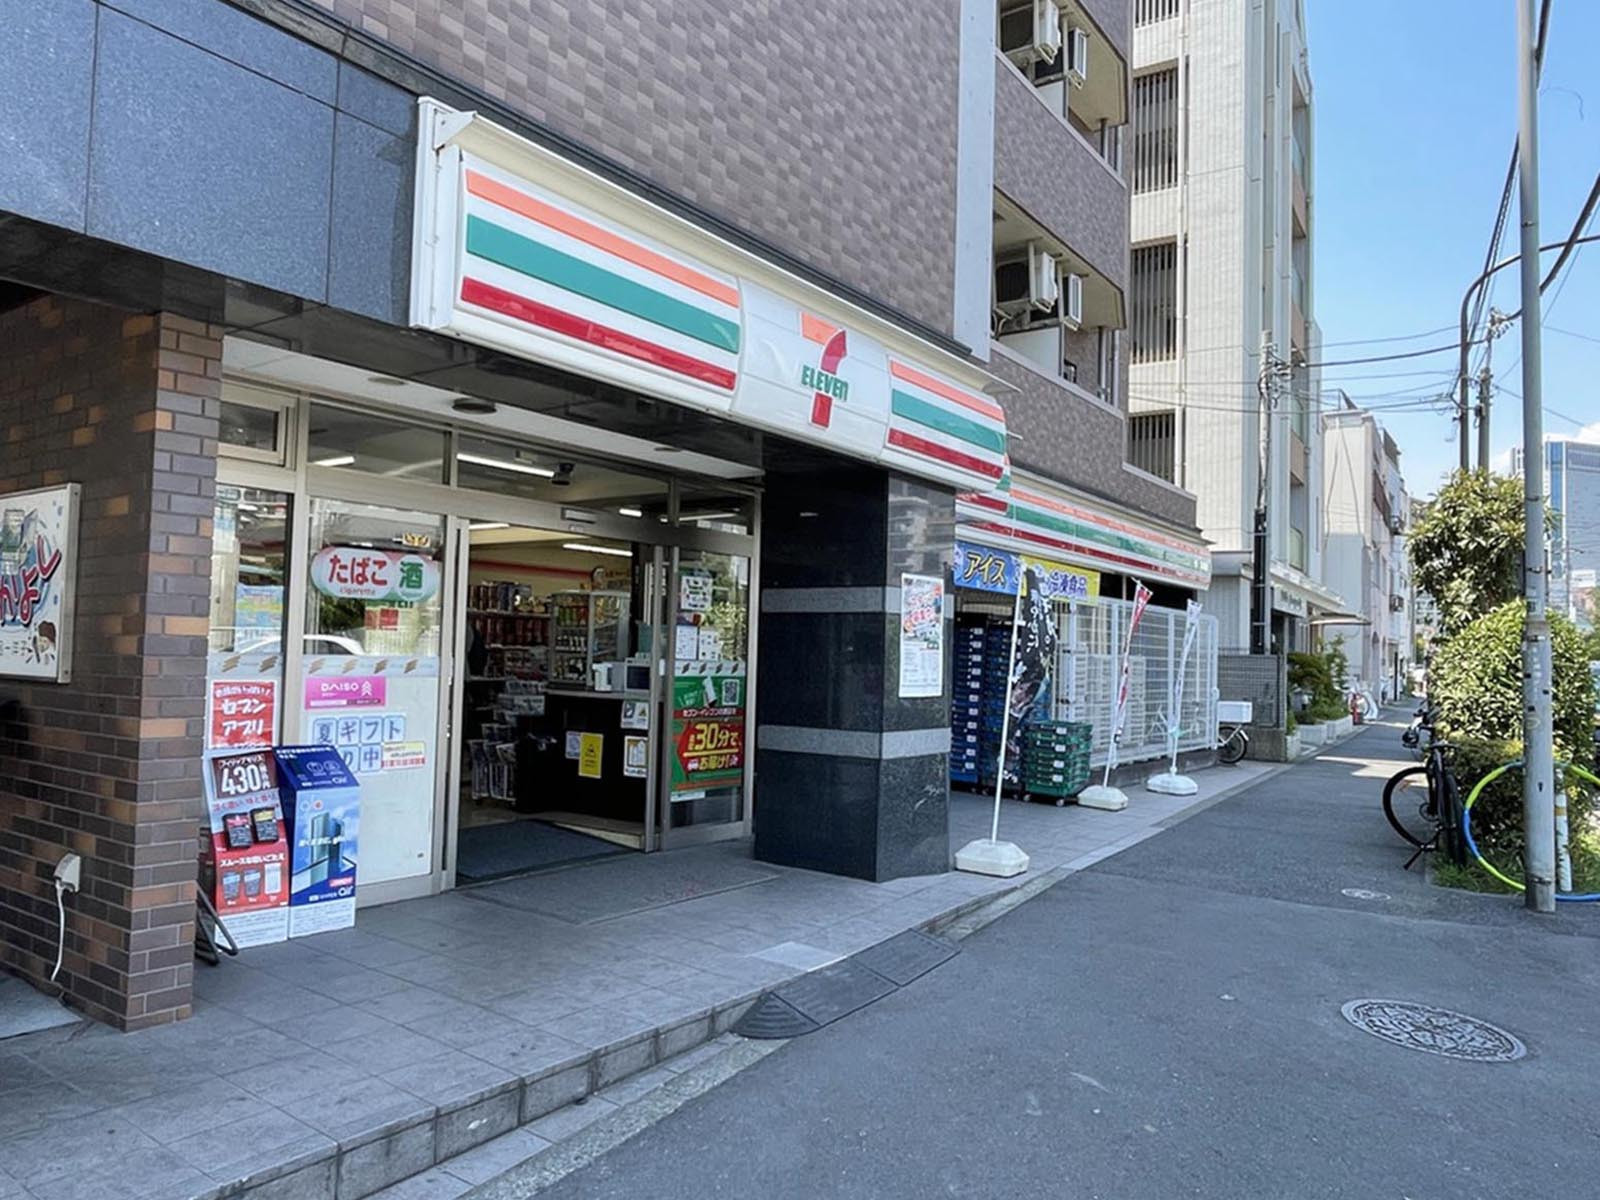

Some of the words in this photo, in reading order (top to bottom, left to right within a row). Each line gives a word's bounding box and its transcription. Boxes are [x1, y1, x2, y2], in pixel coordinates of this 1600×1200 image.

[328, 554, 388, 586] たばこ
[399, 561, 424, 589] 酒
[964, 551, 1006, 586] アイス
[321, 682, 360, 693] DAISO
[222, 699, 267, 715] セブン
[222, 718, 264, 736] アプリ
[317, 720, 401, 745] 夏ギフト
[221, 764, 261, 795] 430
